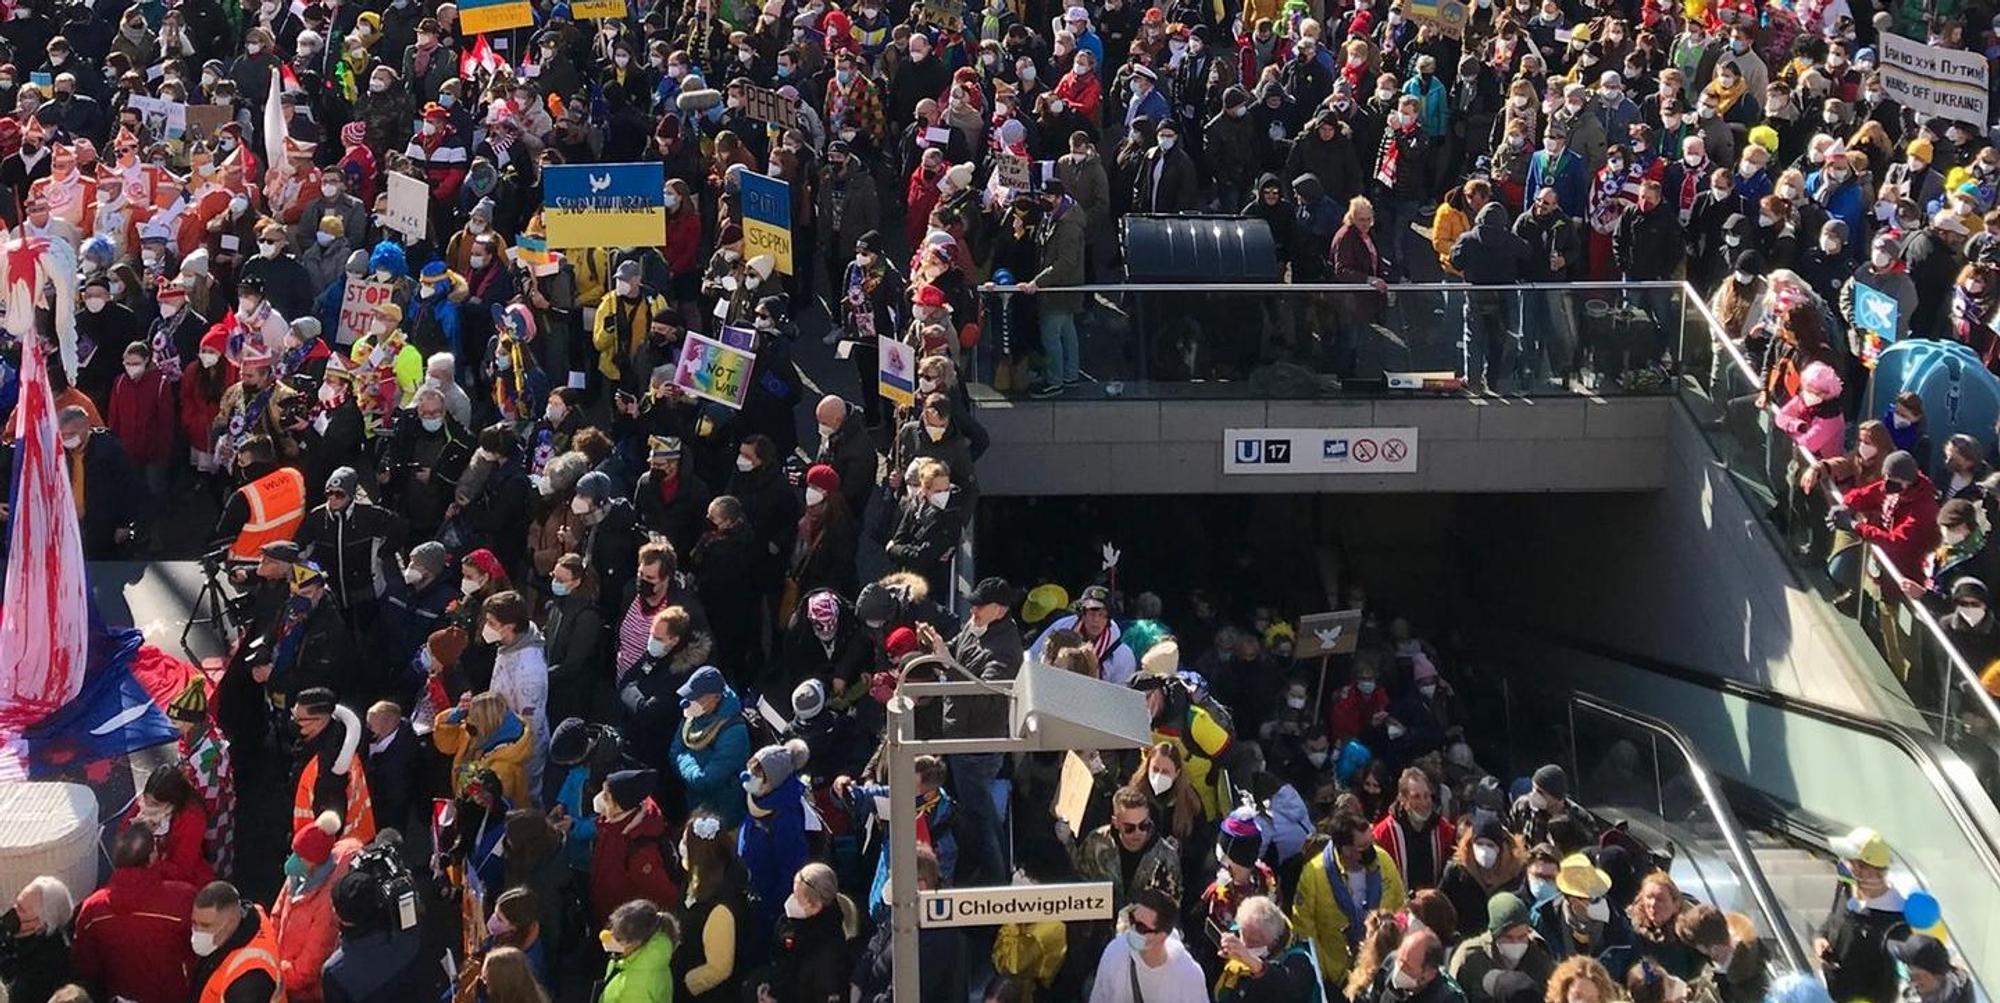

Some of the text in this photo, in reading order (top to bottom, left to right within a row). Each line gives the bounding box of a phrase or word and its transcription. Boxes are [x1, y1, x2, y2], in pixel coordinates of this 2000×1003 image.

[1912, 84, 1931, 100] OFF
[747, 86, 794, 128] PEACE
[347, 284, 390, 305] STOP
[342, 309, 375, 332] PUTI
[705, 362, 736, 382] NOT
[715, 380, 739, 397] WAR
[1238, 441, 1287, 462] U 17
[928, 895, 1105, 921] U Chlodwigplatz
